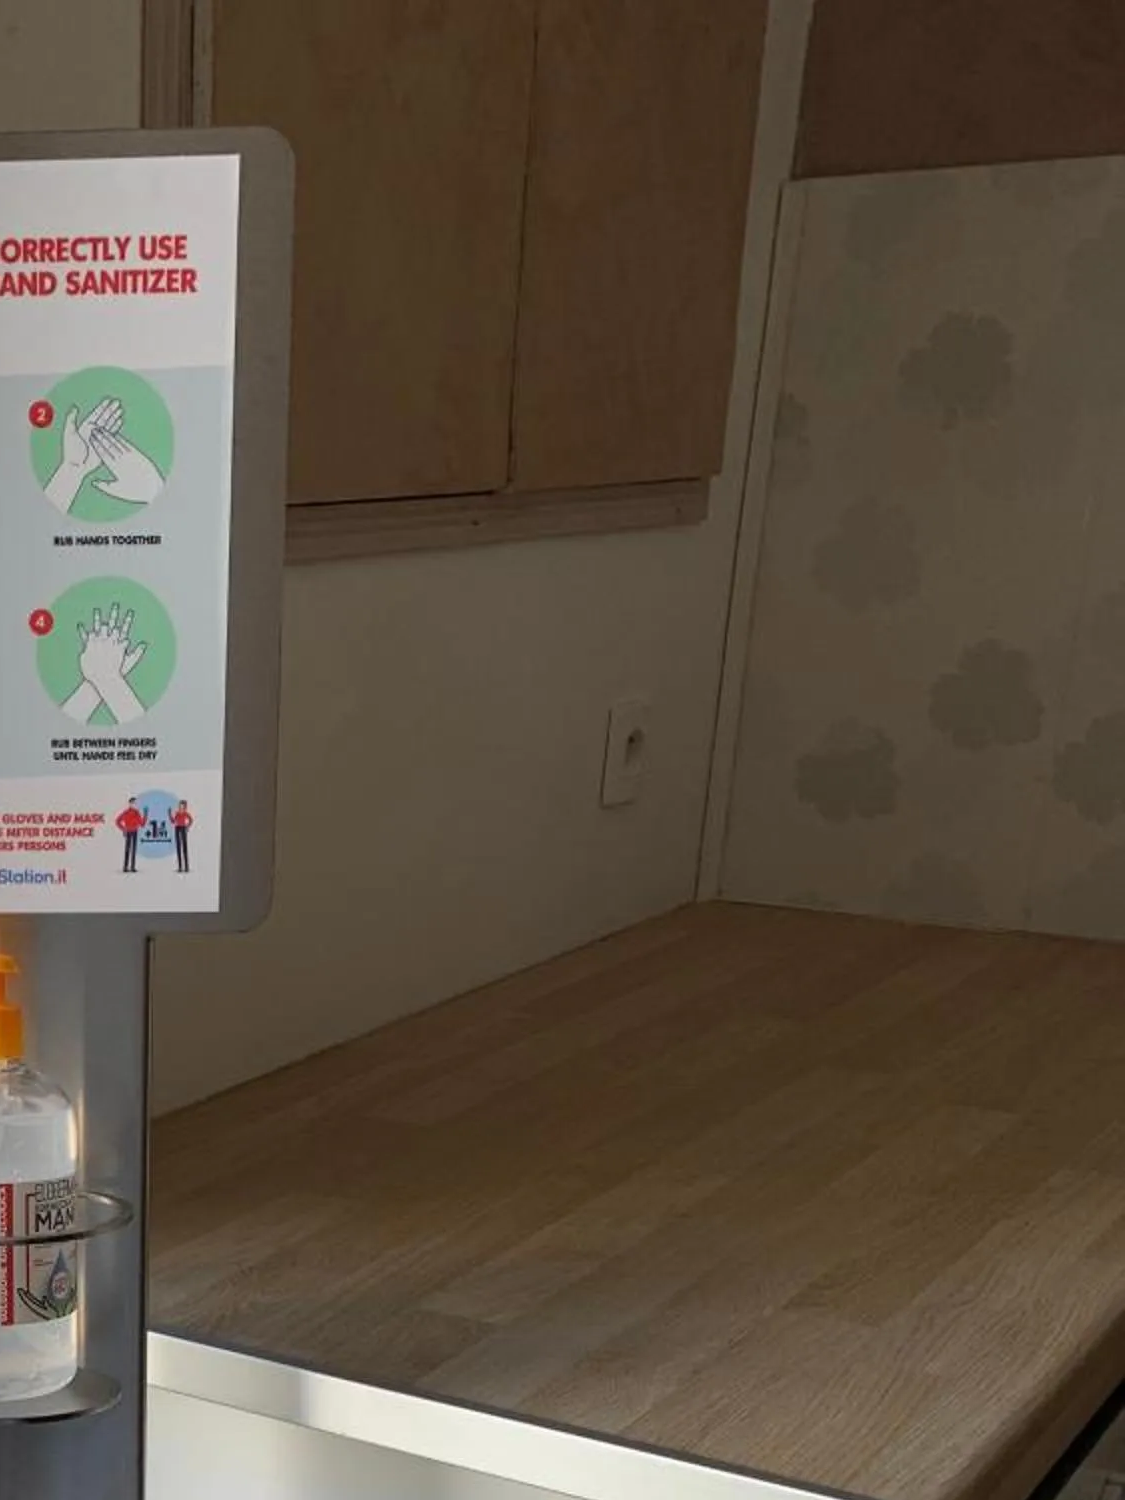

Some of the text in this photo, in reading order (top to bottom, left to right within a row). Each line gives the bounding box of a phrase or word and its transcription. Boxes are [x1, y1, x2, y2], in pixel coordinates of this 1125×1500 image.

[138, 234, 188, 261] USE
[65, 267, 197, 295] SANITIZER
[54, 535, 162, 546] RUB HANDS TOGETHER
[50, 738, 157, 749] RUB BETWEEN FINGERS
[53, 750, 157, 761] UNTIL HANDS FEEL DRY
[3, 813, 44, 824] GLOVES
[47, 813, 71, 824] AND
[74, 813, 106, 824] MASK
[6, 827, 40, 838] METER
[42, 827, 94, 838] DISTANCE
[17, 841, 67, 852] PERSONS
